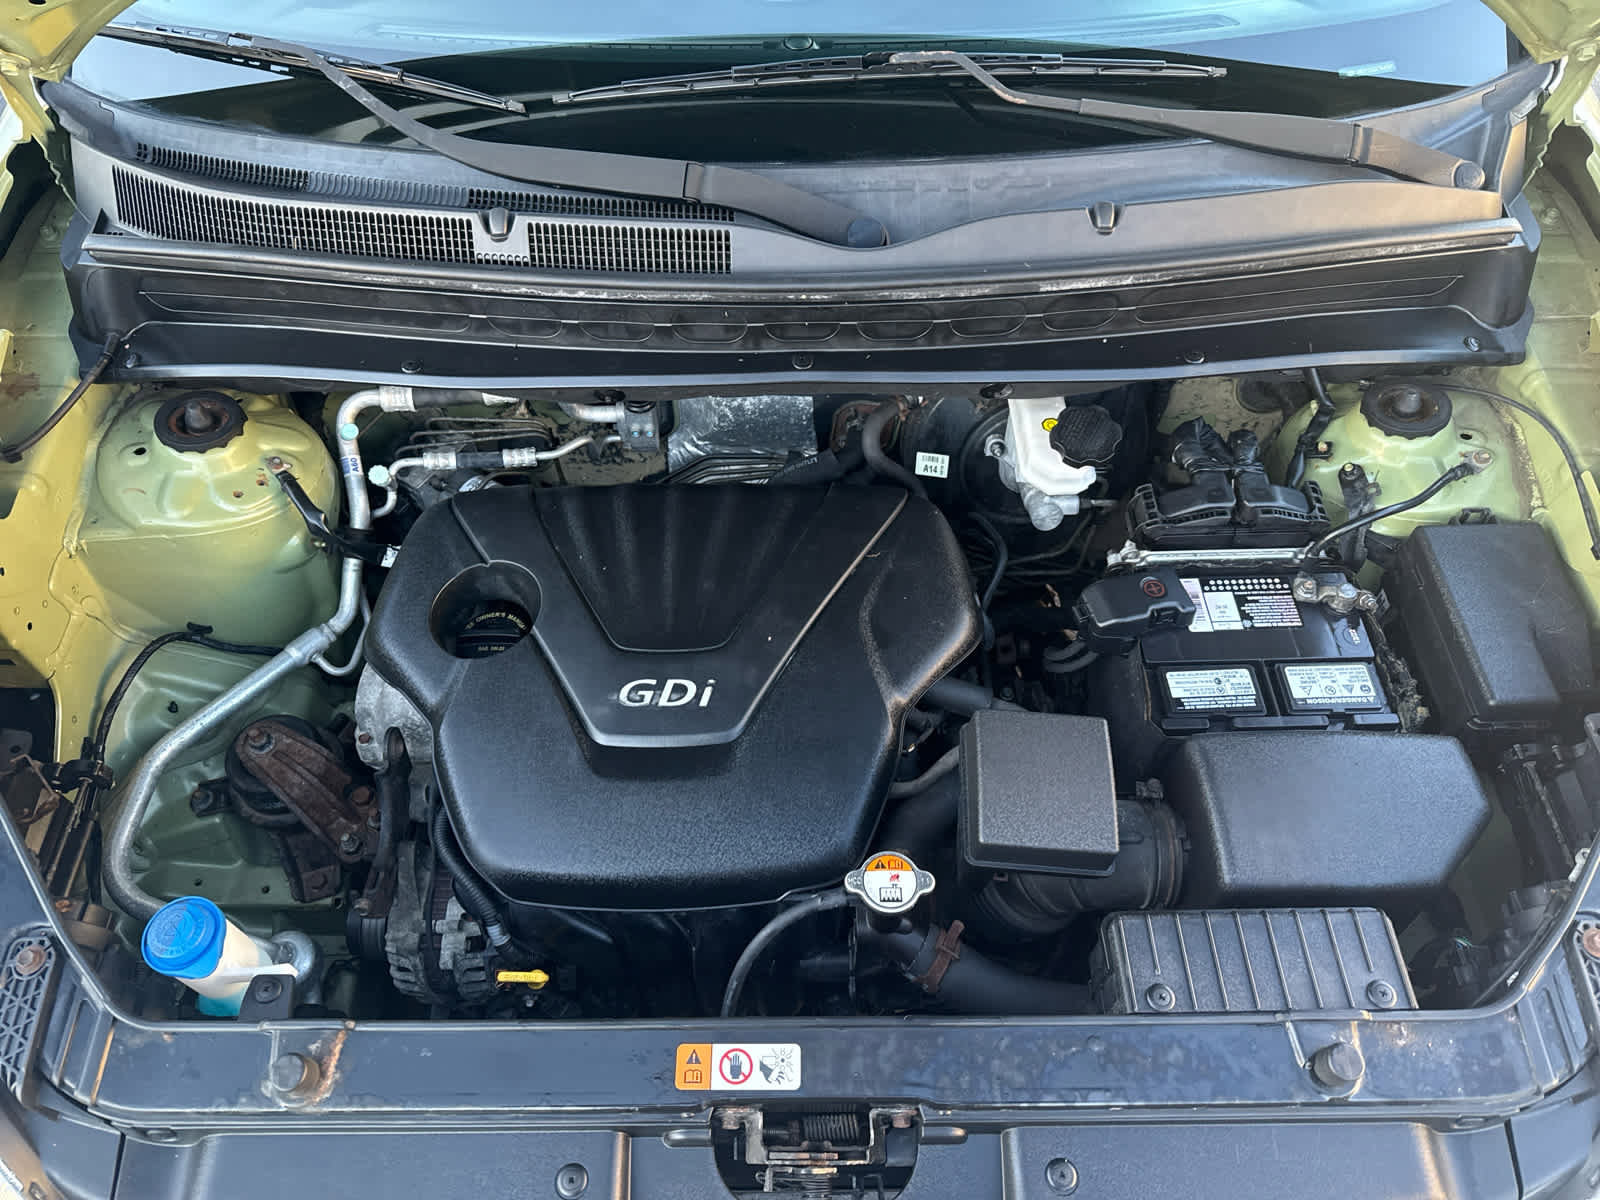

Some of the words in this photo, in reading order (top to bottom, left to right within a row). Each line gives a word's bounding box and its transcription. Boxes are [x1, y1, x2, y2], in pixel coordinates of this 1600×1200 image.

[350, 457, 360, 473] A60
[922, 463, 938, 474] A14
[618, 678, 717, 708] GDi
